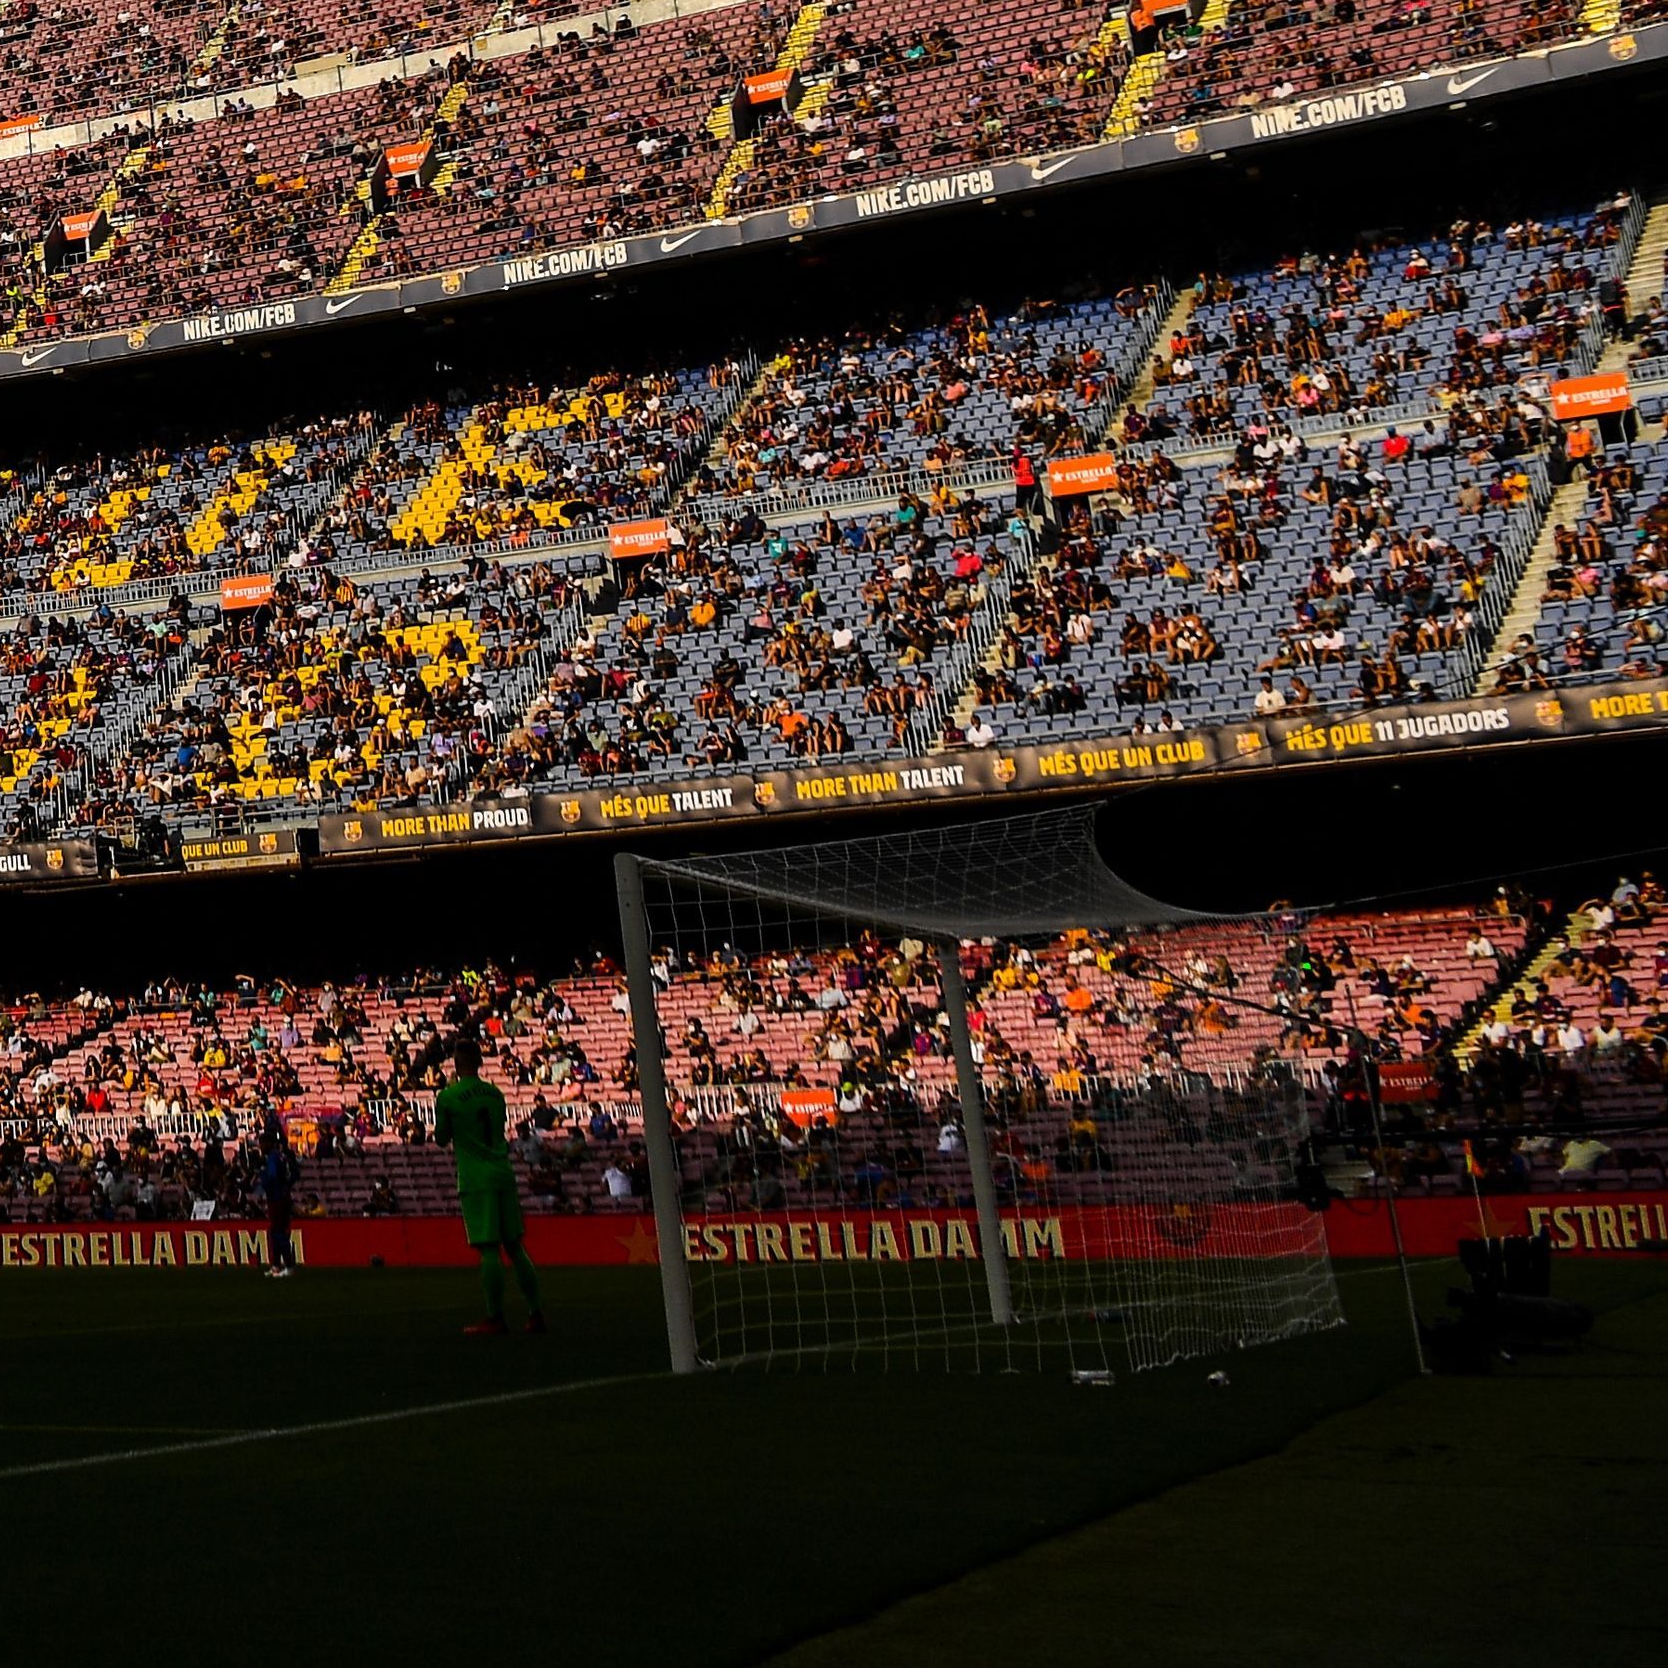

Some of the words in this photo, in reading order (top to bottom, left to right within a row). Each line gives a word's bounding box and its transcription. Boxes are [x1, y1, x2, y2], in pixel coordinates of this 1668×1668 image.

[1251, 85, 1408, 139] NIKE.COM/FCB
[855, 170, 995, 218] NIKE.COM/FCB
[504, 243, 628, 284] NIKE.COM/FCB
[182, 303, 295, 341] NIKE.COM/FCB
[1590, 692, 1655, 720] MORE
[1286, 723, 1328, 751] MÉS
[1330, 722, 1373, 752] QUE
[1375, 721, 1394, 741] 11
[1398, 707, 1510, 740] JUGADORS
[1038, 750, 1078, 777] MÉS
[1079, 748, 1121, 777] QUE
[1123, 745, 1153, 767] UN
[1155, 740, 1205, 765] CLUB
[795, 775, 848, 800] MORE
[848, 771, 899, 795] THAN
[899, 764, 964, 790] TALENT
[381, 815, 425, 837] MORE
[427, 812, 471, 833] THAN
[473, 807, 529, 830] PROUD
[600, 794, 633, 819] MÉS
[635, 794, 671, 820] QUE
[672, 788, 733, 812] TALENT
[205, 841, 220, 857] UN
[222, 838, 248, 855] CLUB
[1, 1230, 177, 1267] ESTRELLA
[684, 1220, 904, 1262] ESTRELLA
